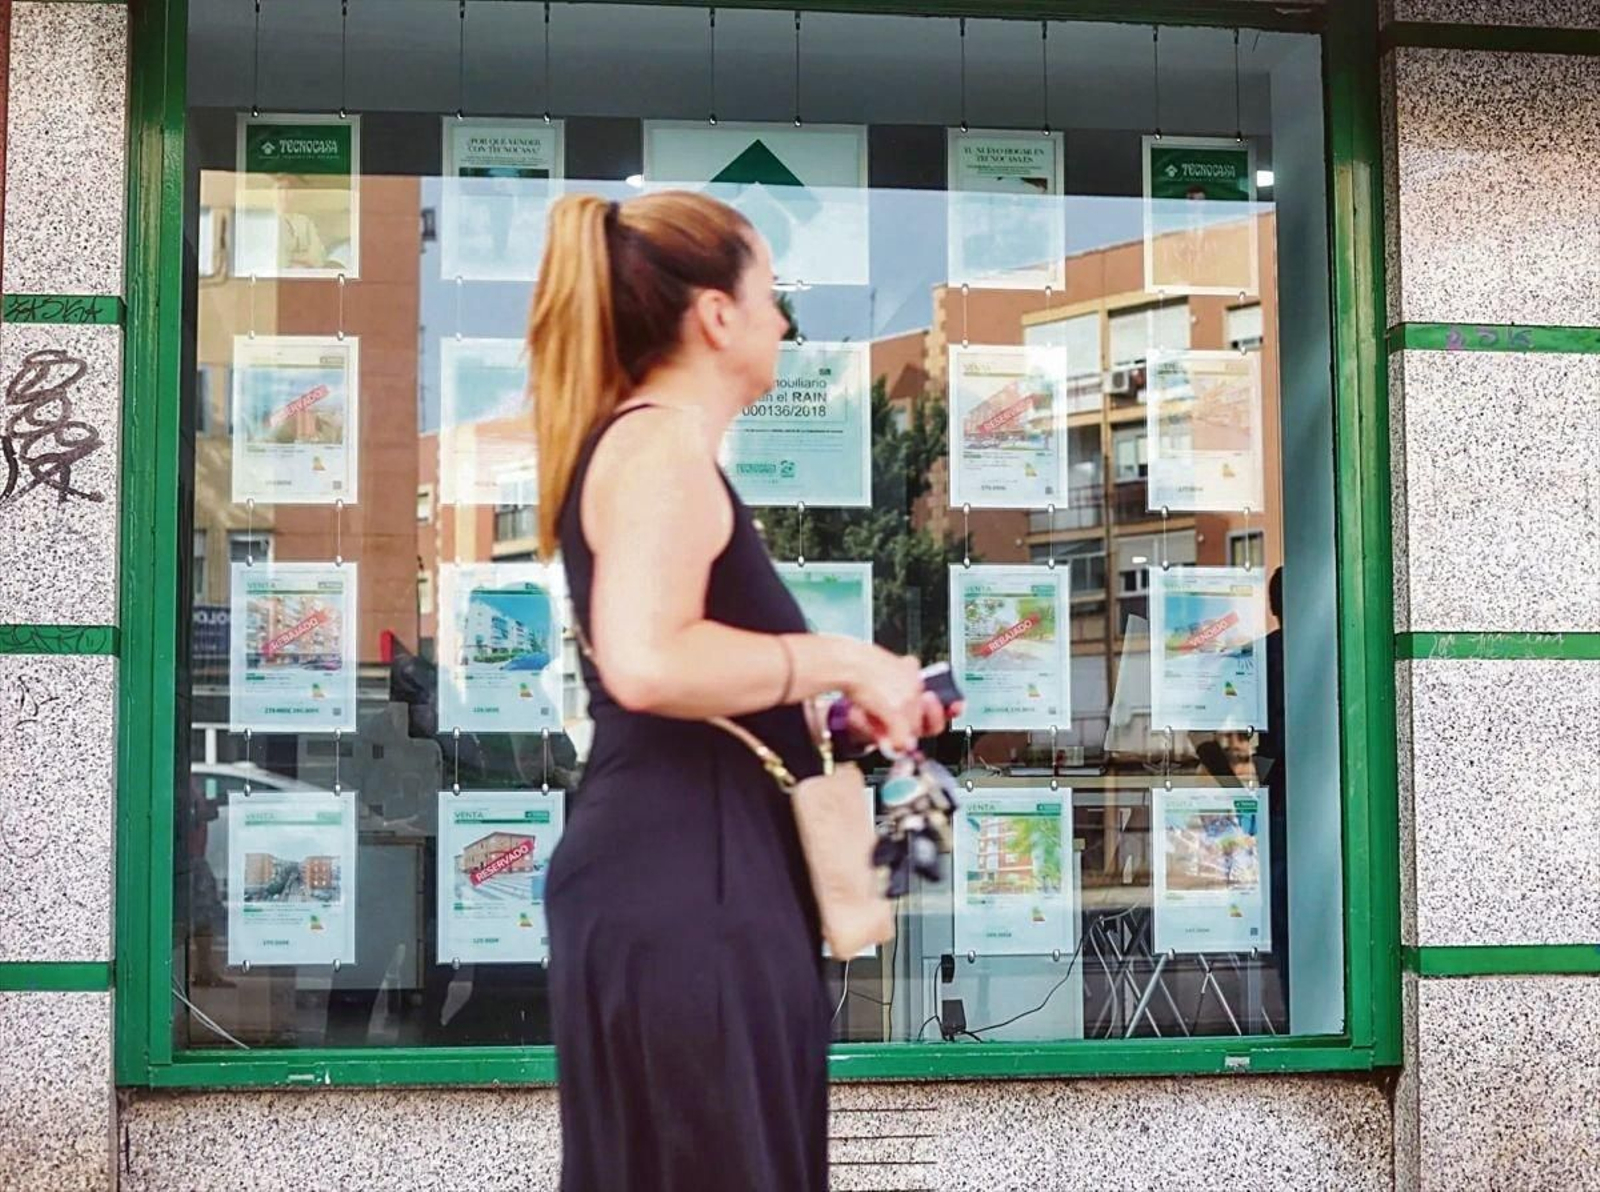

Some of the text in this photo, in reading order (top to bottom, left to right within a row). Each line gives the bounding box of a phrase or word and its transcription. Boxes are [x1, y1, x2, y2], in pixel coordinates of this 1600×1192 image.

[279, 139, 338, 154] TECNOCASA
[1181, 163, 1236, 178] TECNOCASA
[776, 392, 787, 402] el
[792, 391, 827, 402] RAIN
[475, 844, 529, 883] RESERVADO
